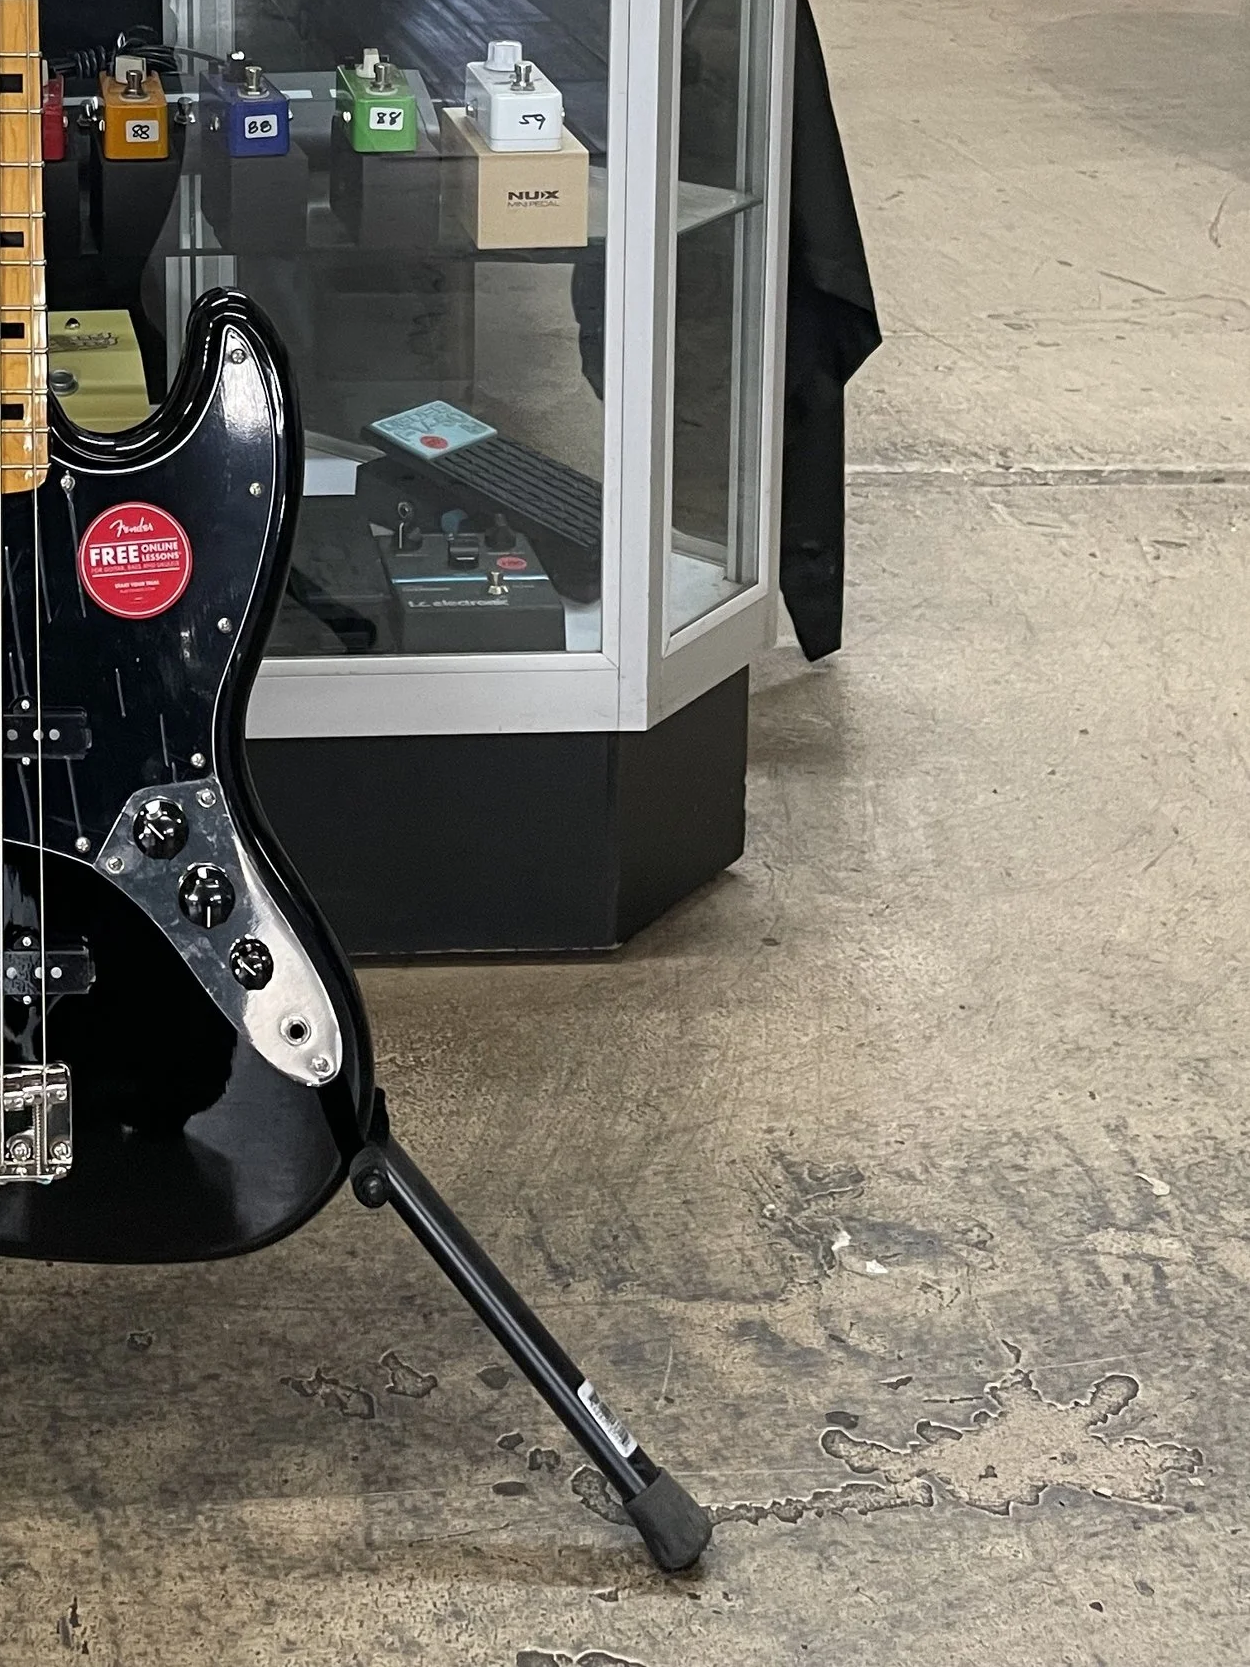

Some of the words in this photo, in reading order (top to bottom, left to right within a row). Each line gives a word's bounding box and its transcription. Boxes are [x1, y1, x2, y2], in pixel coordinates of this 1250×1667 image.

[376, 111, 403, 126] 88
[518, 113, 547, 131] 59
[131, 123, 151, 140] 88
[247, 120, 272, 134] 88
[507, 189, 561, 201] NUX
[529, 200, 561, 208] PEDAL
[109, 516, 154, 538] Fender
[141, 541, 179, 553] ONLINE
[90, 544, 140, 567] FREE
